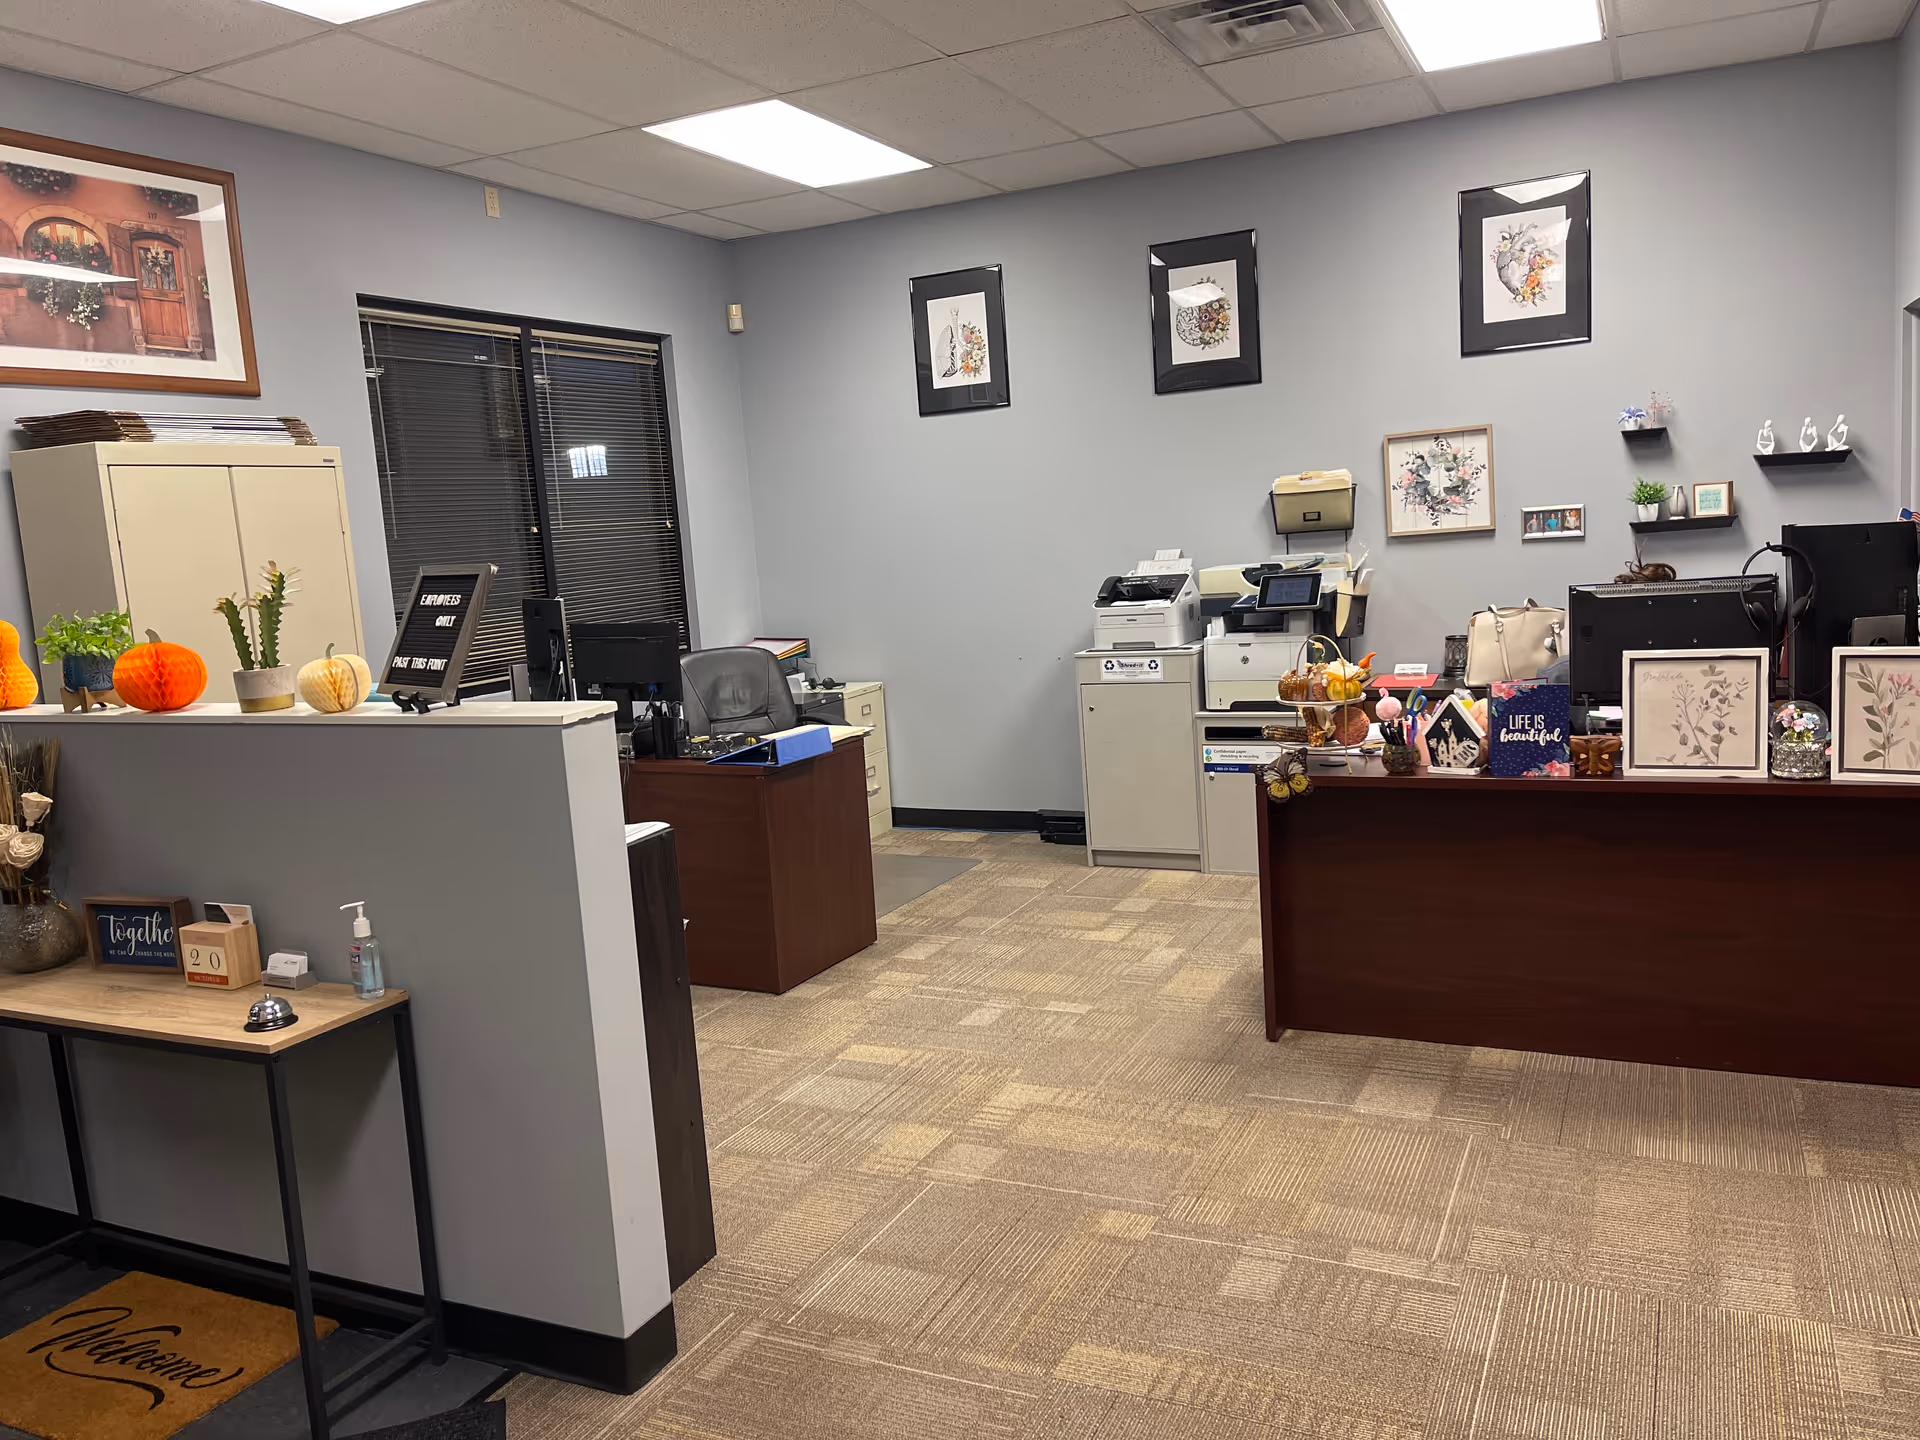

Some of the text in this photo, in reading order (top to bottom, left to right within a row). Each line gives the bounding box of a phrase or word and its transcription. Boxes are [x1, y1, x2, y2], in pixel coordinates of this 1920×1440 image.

[420, 594, 462, 606] EMPLOYEES
[435, 615, 457, 627] ONLY
[392, 656, 448, 671] PAST THIS POINT
[1509, 714, 1545, 730] LIFE IS
[1499, 727, 1563, 747] beautiful
[27, 1306, 245, 1410] Welcome
